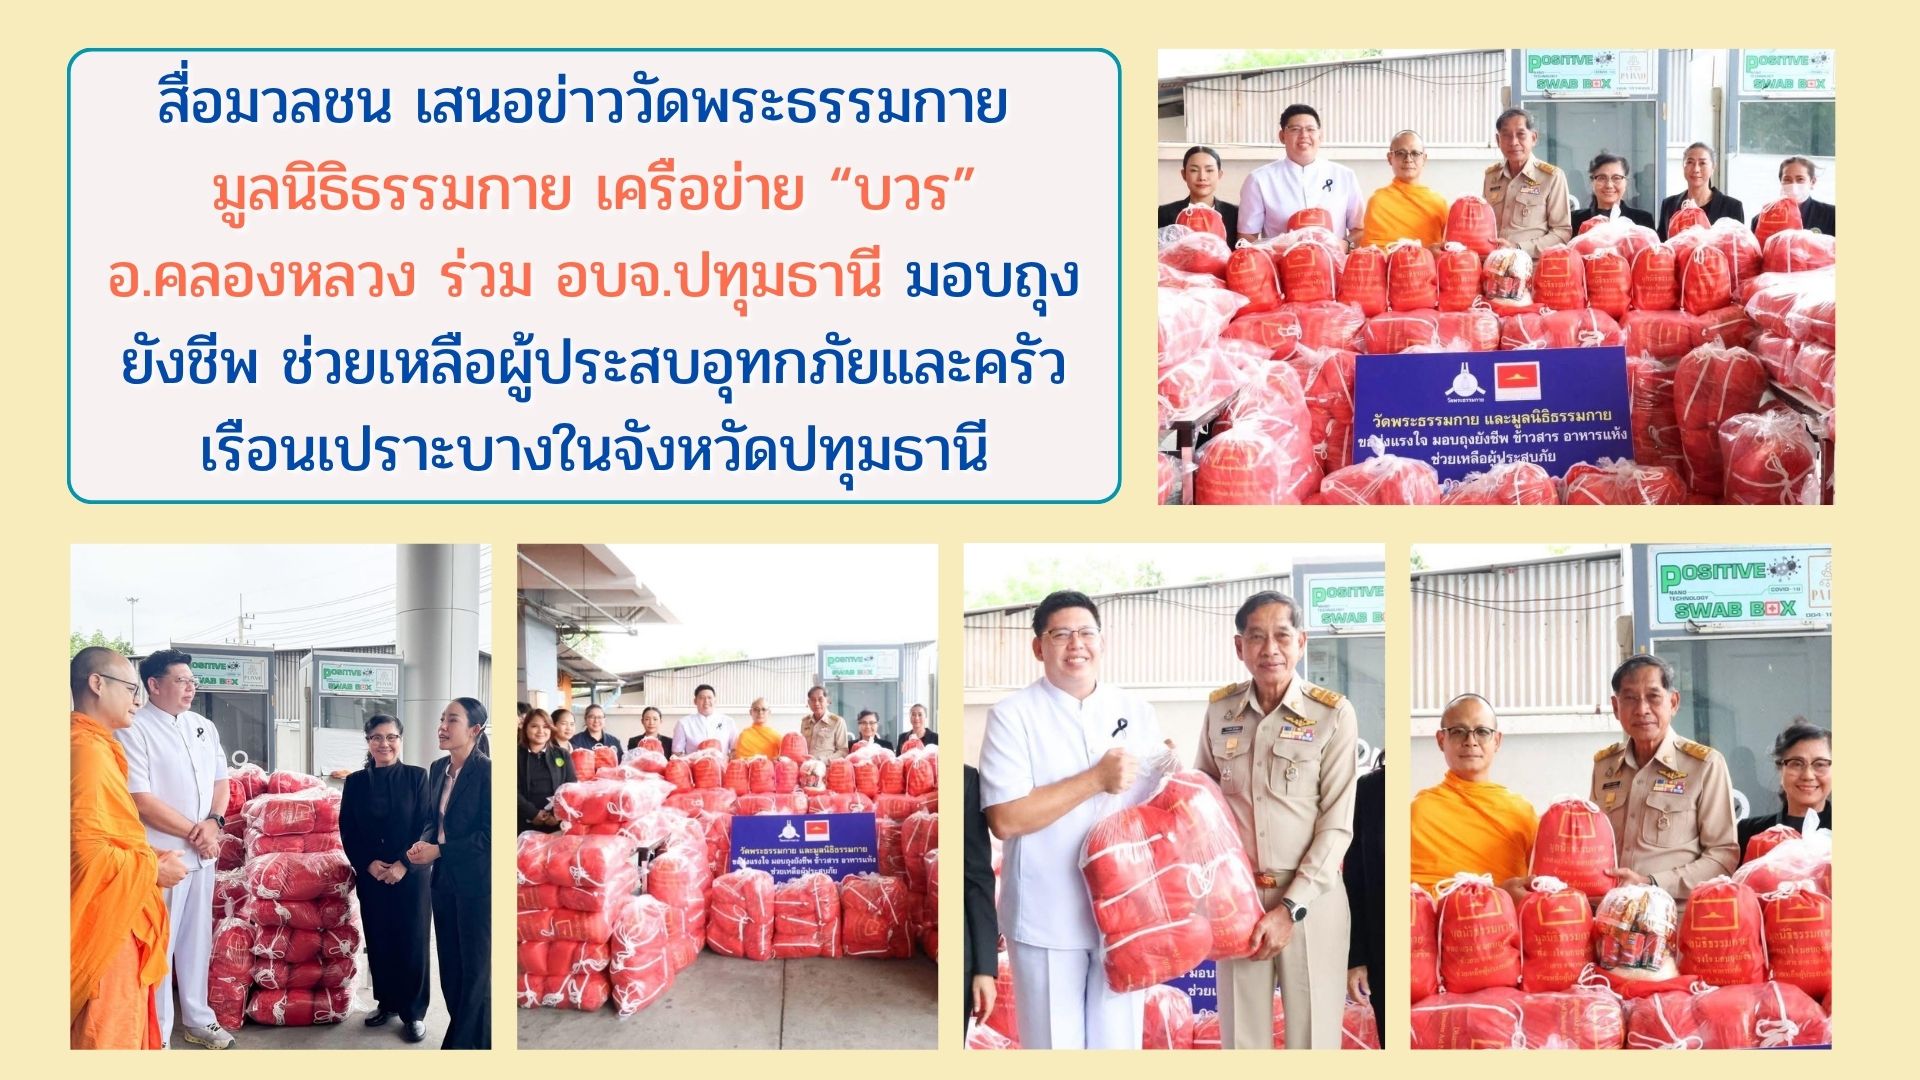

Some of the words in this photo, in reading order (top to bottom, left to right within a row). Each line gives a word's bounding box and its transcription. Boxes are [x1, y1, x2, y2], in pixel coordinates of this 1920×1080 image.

[1528, 54, 1594, 73] POSITIVE
[1745, 55, 1810, 73] POSITIVE
[1537, 78, 1579, 89] SWAB
[1753, 79, 1794, 89] SWAB
[1373, 413, 1481, 428] วัดพระธรรมกาย
[1484, 408, 1613, 429] และมูลนิธิธรรมกาย
[1357, 430, 1428, 448] ขอ่งแรงใจ
[1432, 430, 1509, 450] มอบถุงยังชีพ
[1513, 429, 1560, 444] ข้าวสาร
[1563, 426, 1629, 443] อาหารแห้ง
[1661, 562, 1767, 594] POSITIVE
[1311, 585, 1384, 608] POSITIVE
[1321, 612, 1368, 624] SWAB
[1674, 601, 1743, 619] SWAB
[1750, 600, 1797, 618] BOX
[192, 662, 226, 670] OSITIVE
